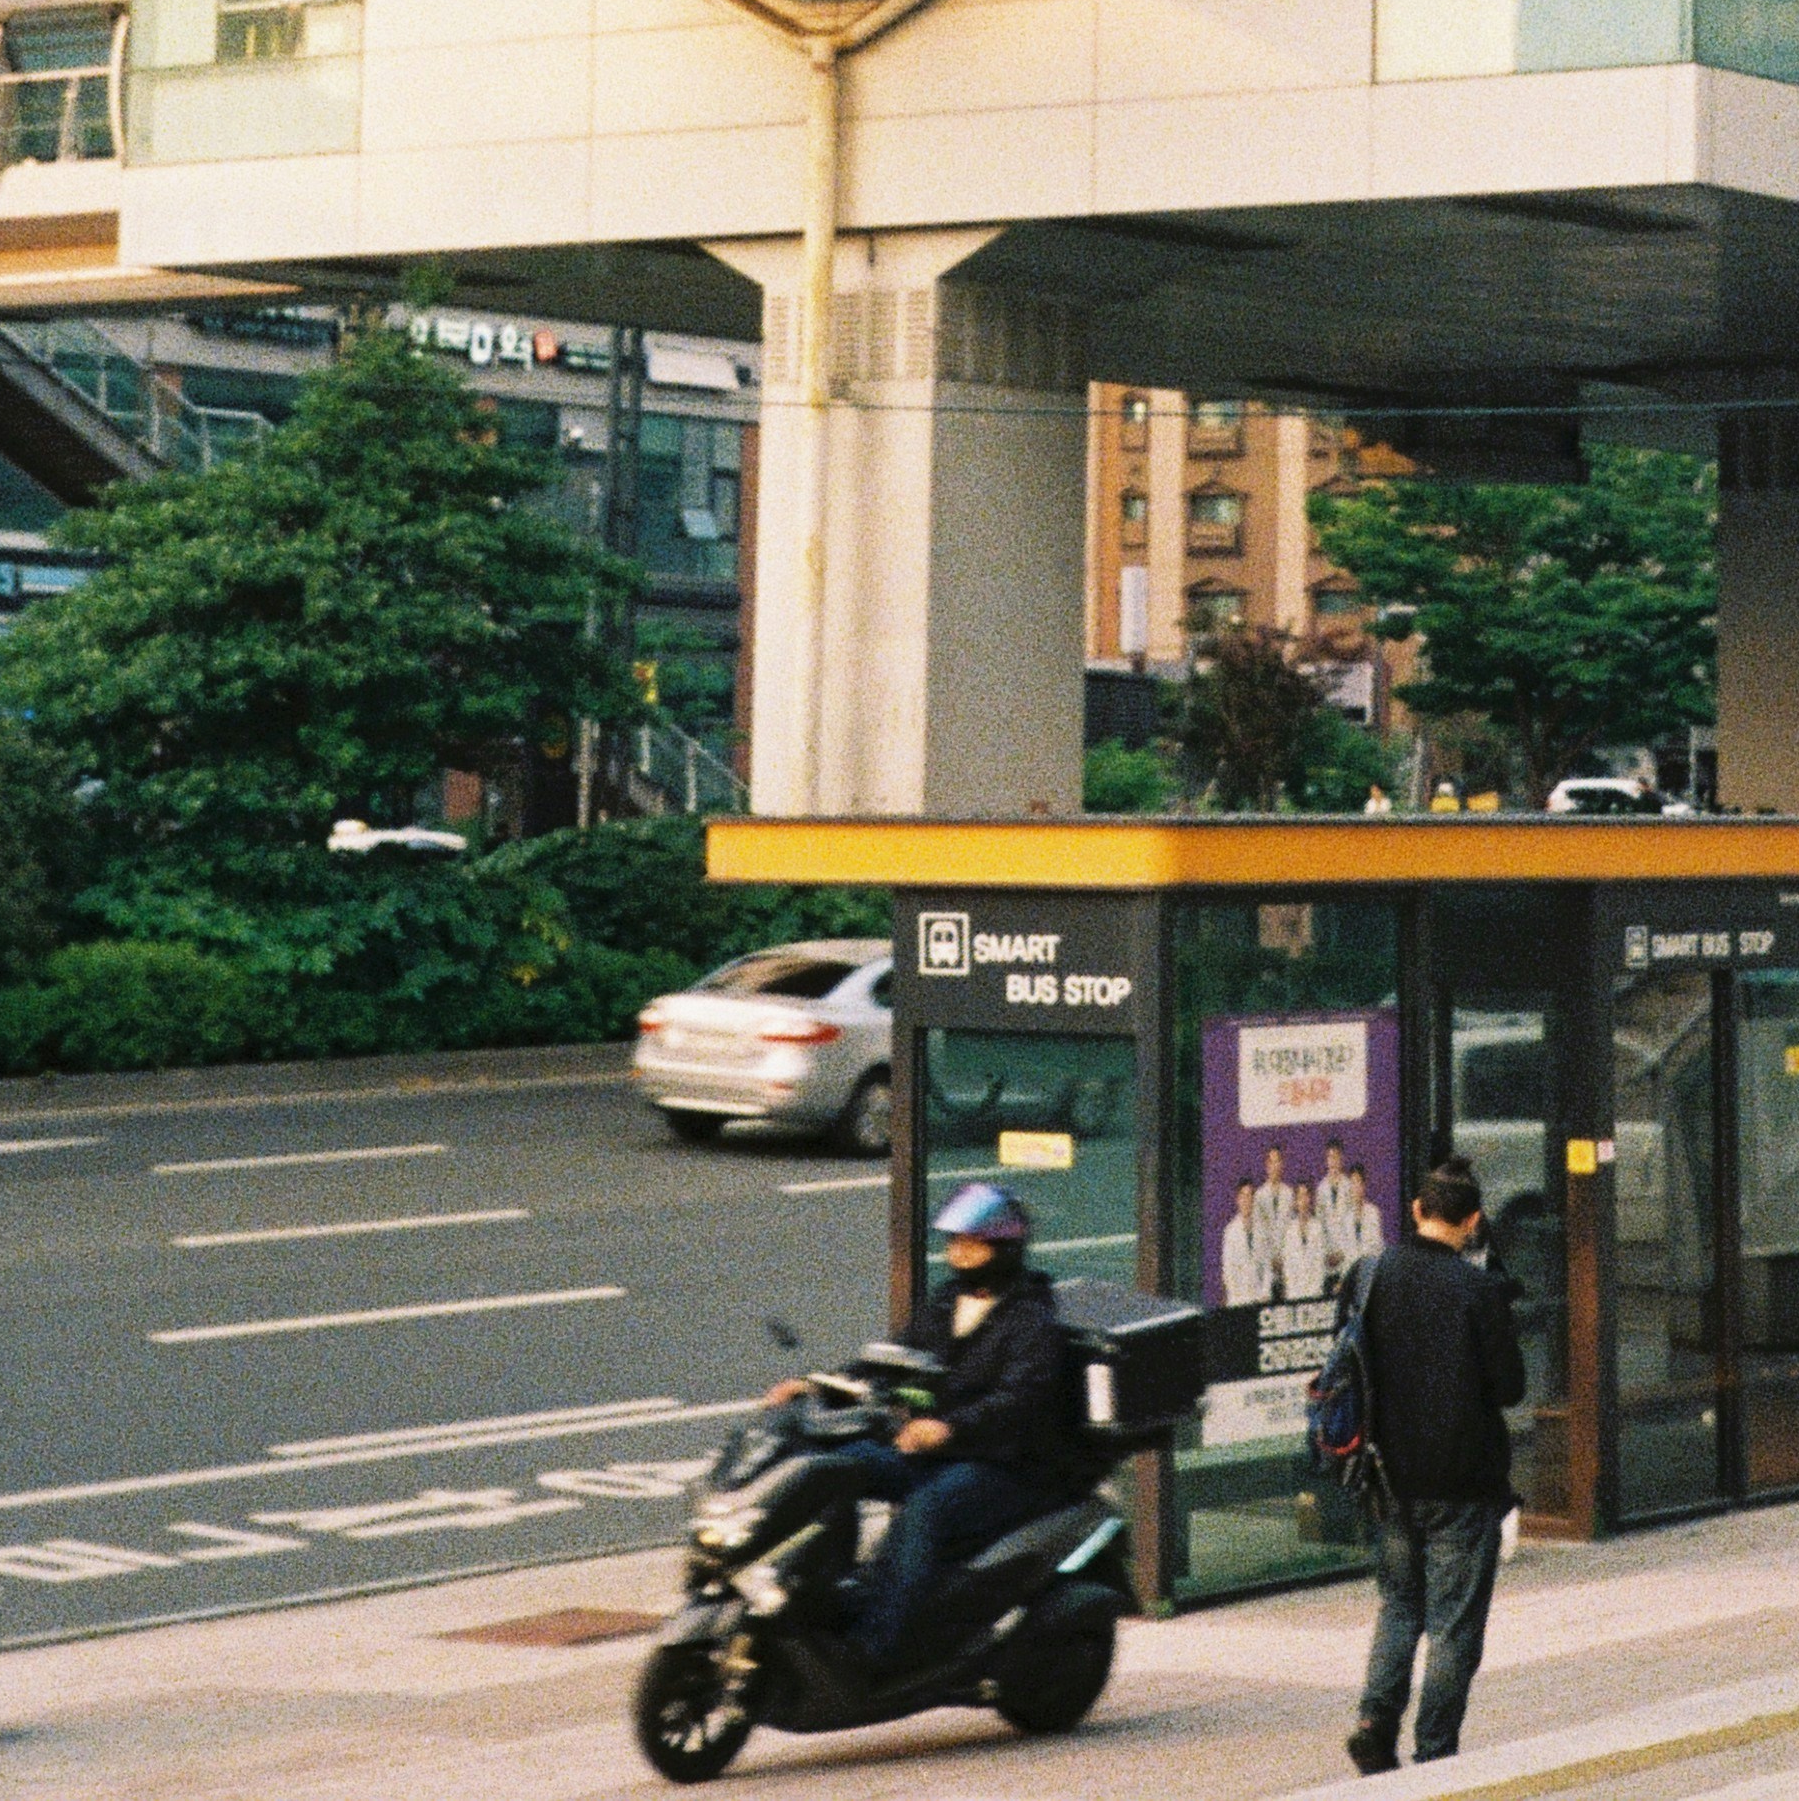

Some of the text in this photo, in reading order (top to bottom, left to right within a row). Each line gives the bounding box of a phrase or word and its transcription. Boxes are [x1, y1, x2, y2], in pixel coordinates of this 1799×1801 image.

[972, 933, 1061, 966] SMART
[1651, 933, 1698, 958] SMART
[1701, 931, 1731, 957] BUS
[1738, 930, 1775, 957] STOP
[1005, 974, 1133, 1008] BUS STOP
